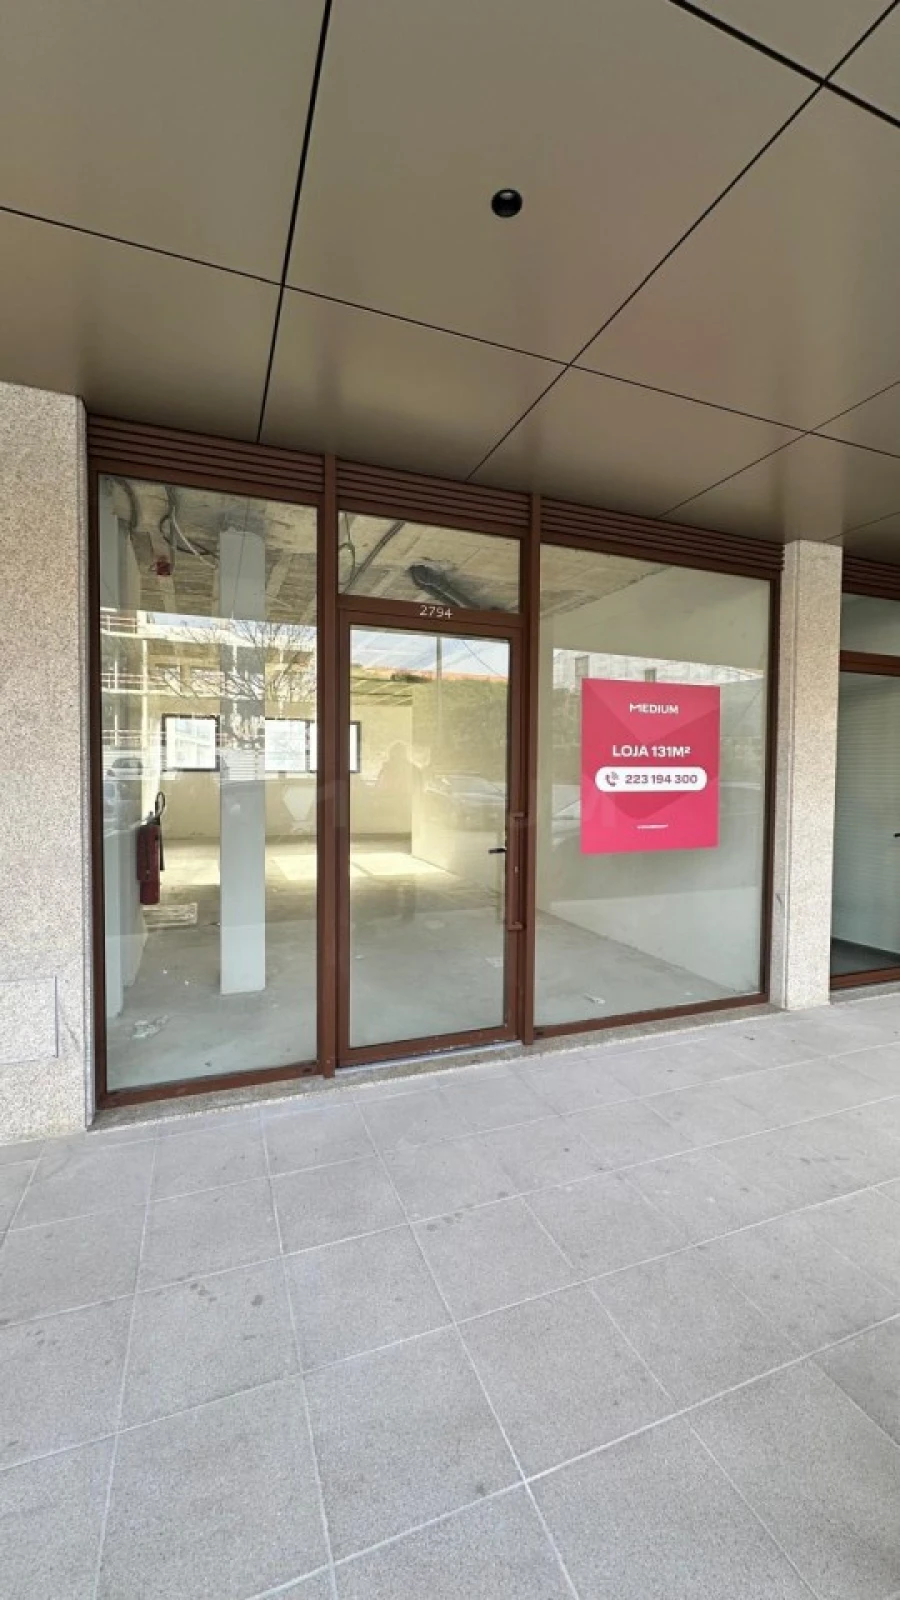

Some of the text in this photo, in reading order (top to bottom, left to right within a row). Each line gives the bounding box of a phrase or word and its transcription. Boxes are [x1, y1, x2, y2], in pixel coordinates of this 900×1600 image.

[420, 604, 453, 618] 2794
[630, 703, 679, 714] MEDIUM
[612, 745, 691, 758] LOJA 131M²
[625, 774, 697, 784] 223 194 300
